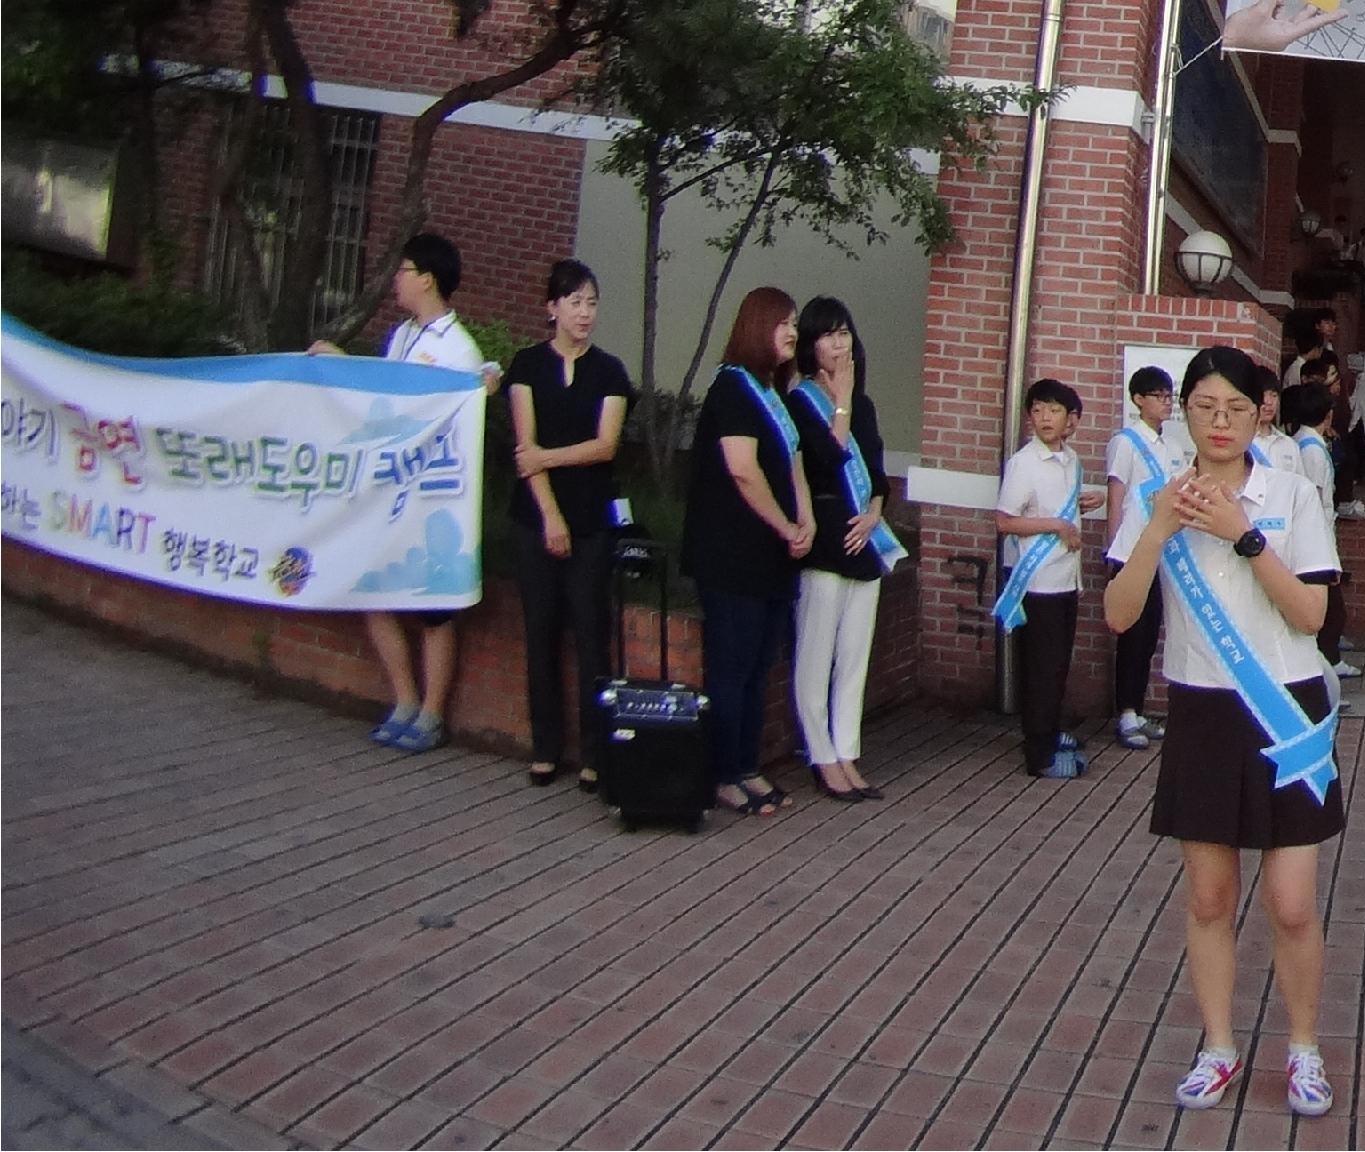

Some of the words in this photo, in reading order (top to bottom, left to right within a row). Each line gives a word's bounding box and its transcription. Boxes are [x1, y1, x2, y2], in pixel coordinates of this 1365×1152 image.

[61, 401, 144, 486] 금연
[155, 427, 364, 508] 또래도우미
[49, 490, 157, 554] SMART
[163, 528, 260, 581] 행복학교
